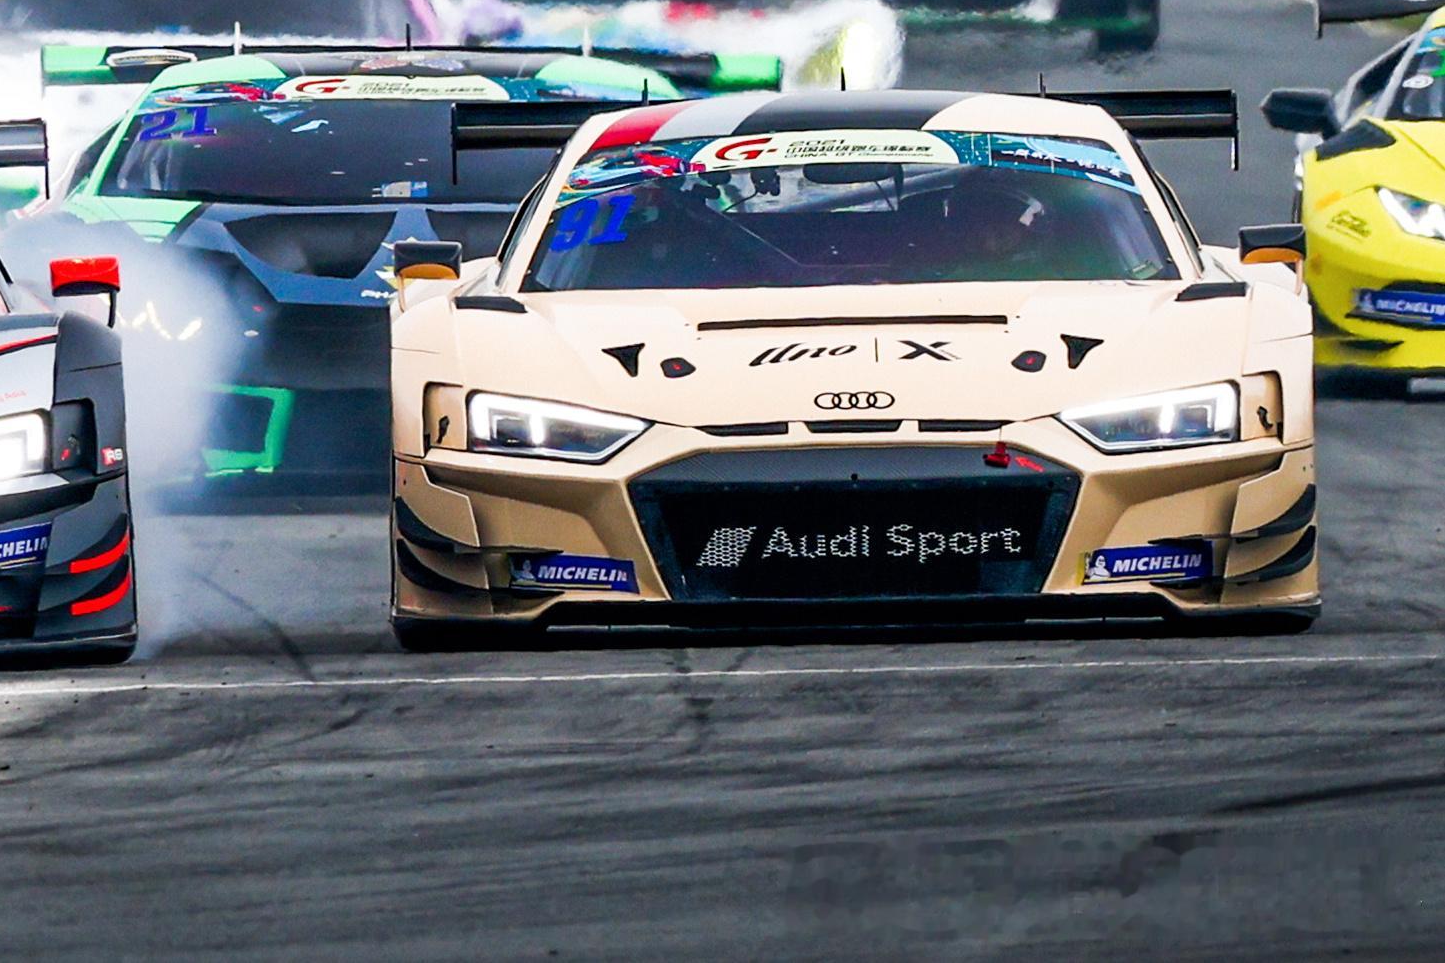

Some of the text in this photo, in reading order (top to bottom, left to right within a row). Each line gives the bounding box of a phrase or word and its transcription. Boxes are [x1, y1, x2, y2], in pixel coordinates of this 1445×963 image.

[137, 106, 217, 142] 21
[551, 195, 637, 251] 91
[761, 523, 1022, 564] Audi Sport
[537, 565, 628, 582] MICHELIN
[1112, 553, 1203, 573] MICHELIN
